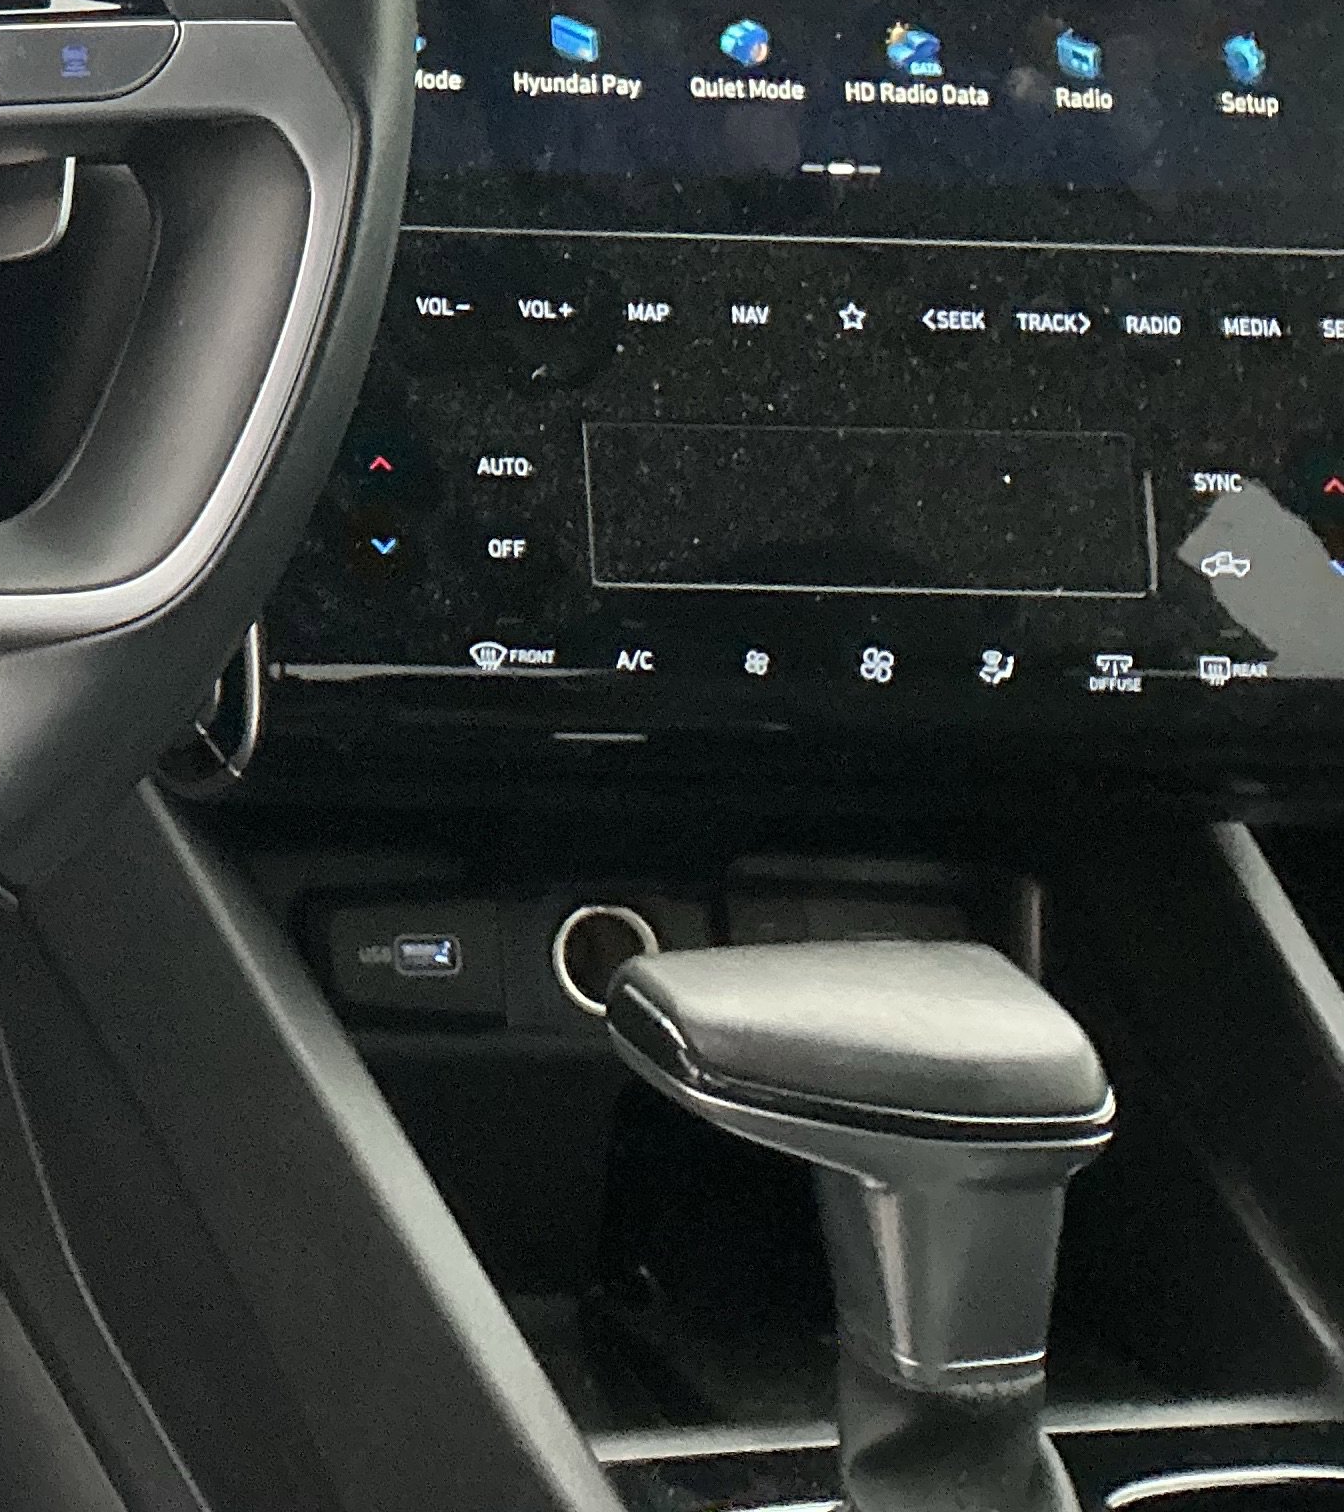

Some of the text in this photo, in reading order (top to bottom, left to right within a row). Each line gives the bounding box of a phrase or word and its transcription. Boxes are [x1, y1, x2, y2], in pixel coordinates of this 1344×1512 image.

[513, 70, 642, 100] Hyundai Pay
[690, 76, 805, 101] Quiet Mode
[844, 81, 990, 107] HD Radio Data
[1055, 87, 1113, 110] Radio
[1221, 91, 1279, 118] Setup
[627, 302, 670, 323] MAP
[731, 304, 769, 325] NAV
[1125, 314, 1182, 335] RADIO
[1222, 316, 1282, 337] MEDIA
[476, 456, 529, 477] AUTO
[1194, 473, 1242, 494] SYNC
[487, 538, 526, 559] OFF
[509, 648, 556, 666] FRONT
[615, 649, 654, 671] A/C
[1088, 675, 1143, 693] DIFFUSE
